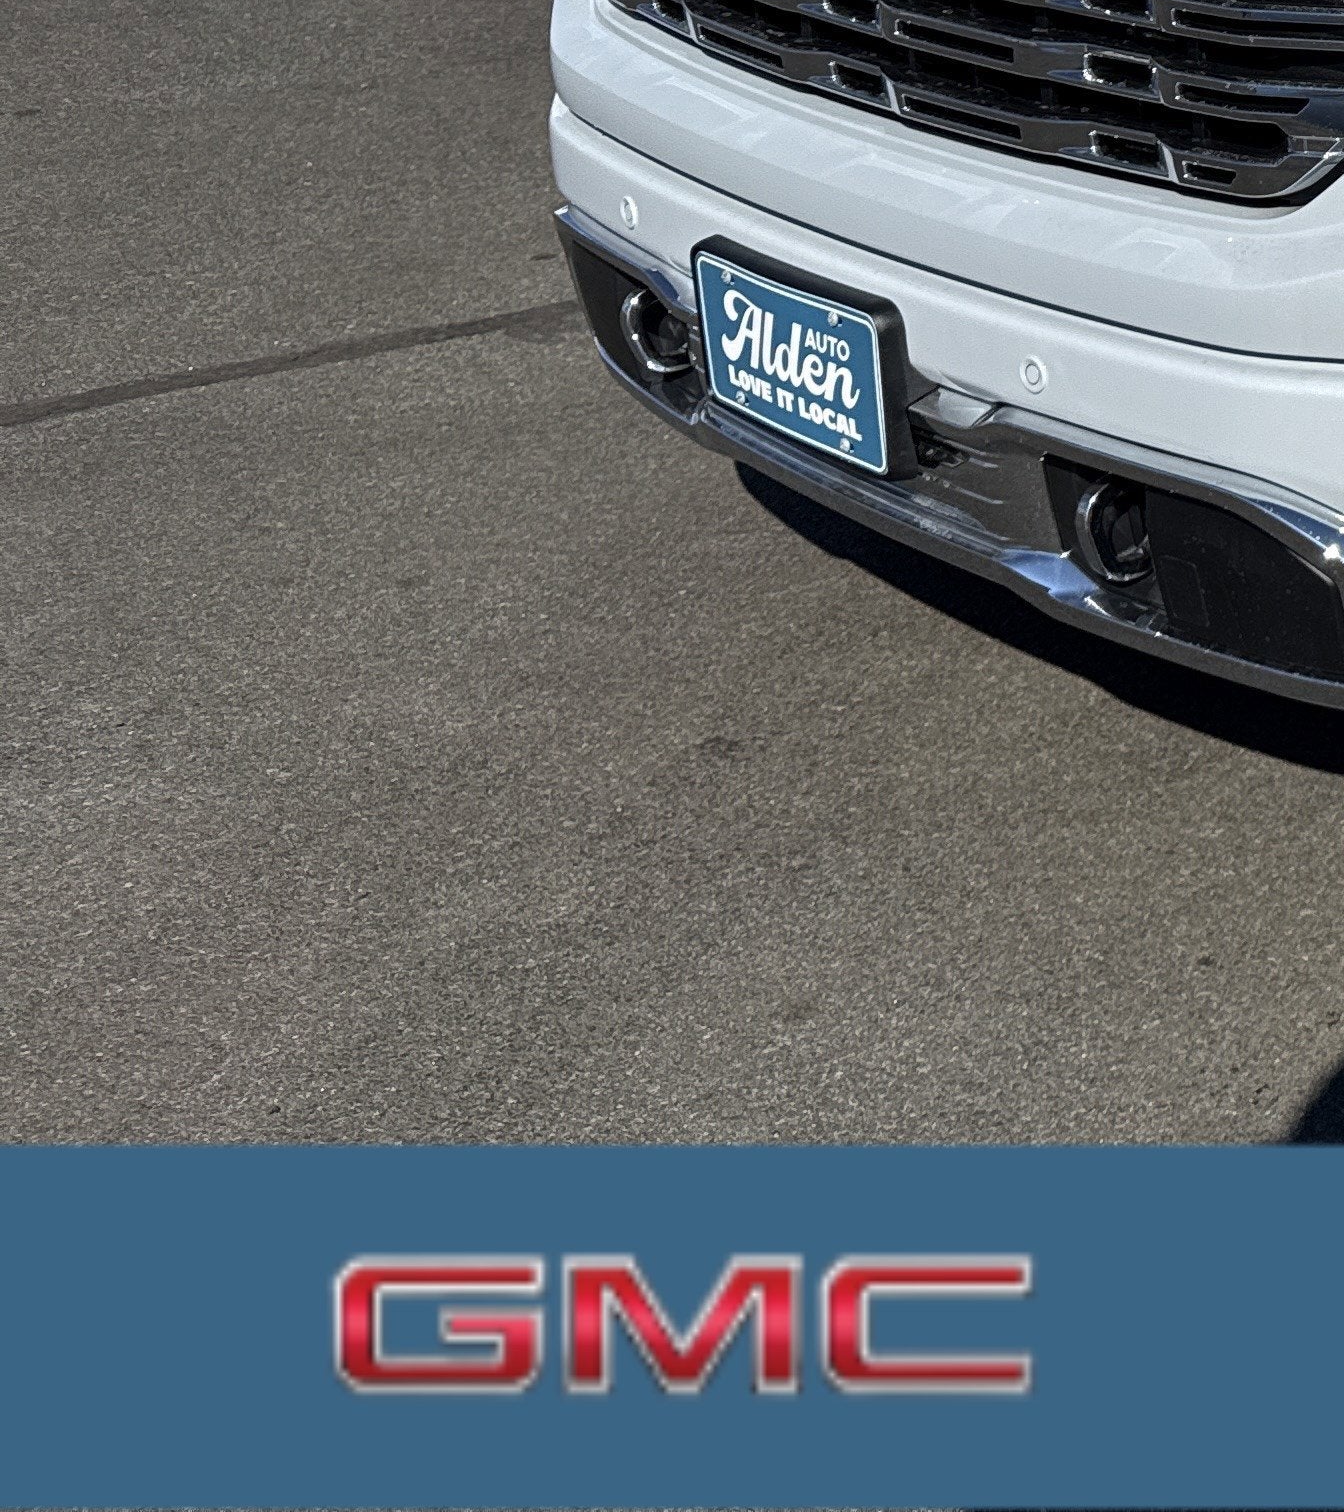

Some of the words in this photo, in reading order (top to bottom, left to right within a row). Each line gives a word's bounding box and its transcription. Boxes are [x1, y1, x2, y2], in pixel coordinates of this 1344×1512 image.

[721, 289, 860, 410] Alden
[804, 328, 851, 362] AUTO
[727, 364, 773, 404] LOVE
[776, 386, 795, 412] IT
[798, 397, 863, 441] LOCAL
